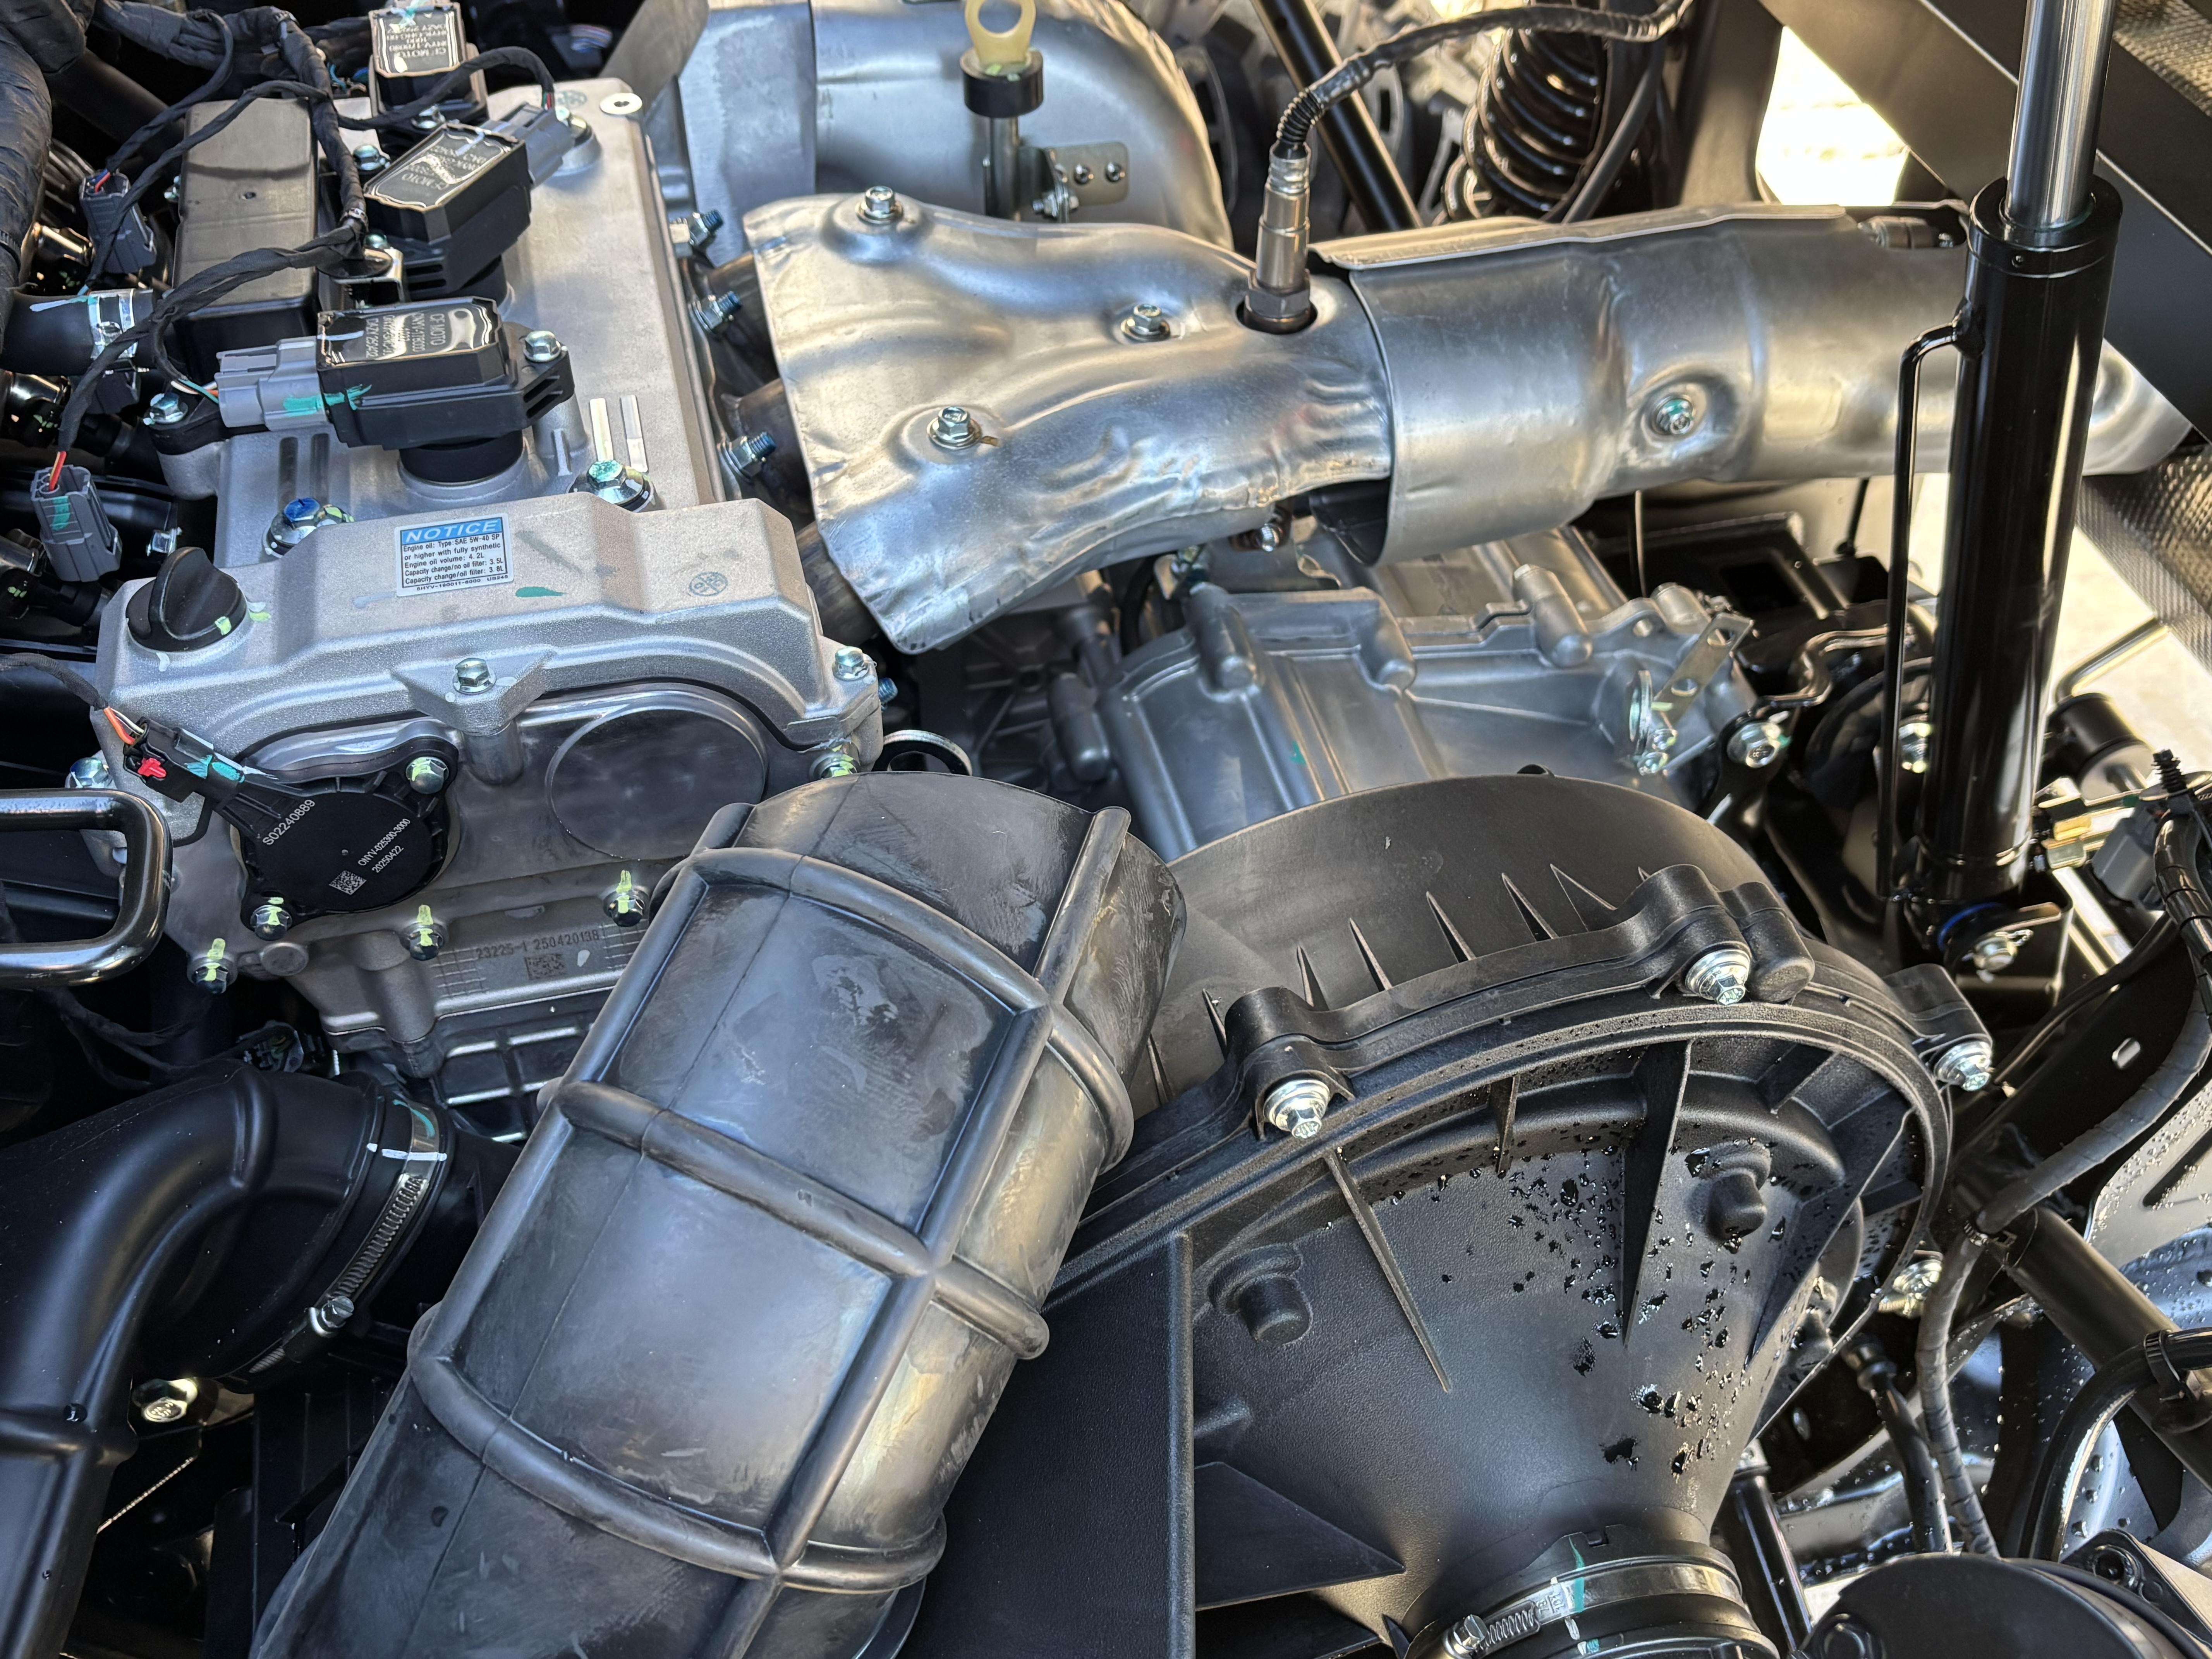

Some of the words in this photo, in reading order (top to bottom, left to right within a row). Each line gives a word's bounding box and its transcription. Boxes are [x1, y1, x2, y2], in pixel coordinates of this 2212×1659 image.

[430, 324, 446, 345] MOTO
[406, 520, 498, 543] NOTICE
[414, 552, 435, 560] higher
[471, 543, 501, 552] synthetic
[405, 576, 432, 584] Capacity
[434, 570, 467, 580] change/oil
[431, 564, 461, 573] change/no
[263, 800, 315, 845] S02240889
[372, 845, 404, 873] 20250422
[533, 929, 599, 950] 250420138
